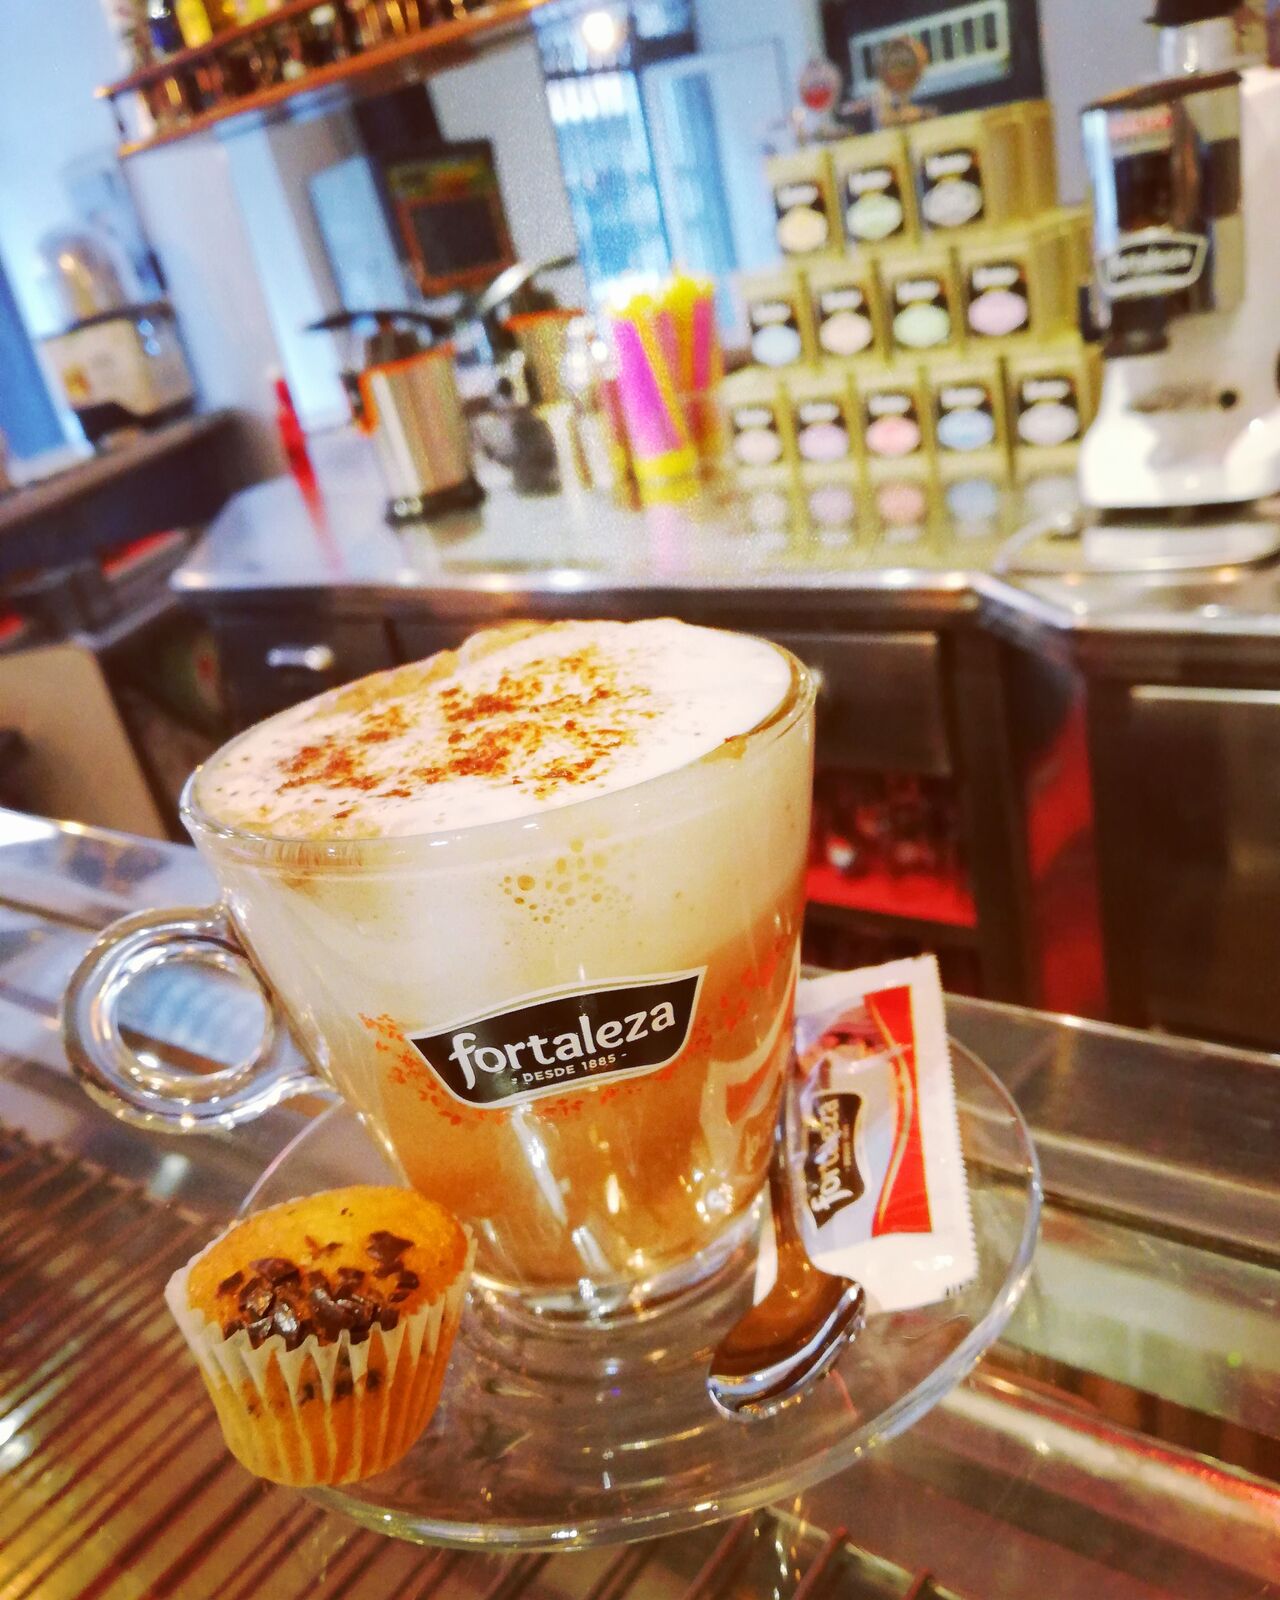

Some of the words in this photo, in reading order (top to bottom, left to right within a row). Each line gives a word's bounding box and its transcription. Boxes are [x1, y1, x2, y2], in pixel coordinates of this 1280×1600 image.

[448, 1001, 676, 1090] fortaleza
[522, 1064, 576, 1083] DESDE
[581, 1053, 617, 1070] 1885
[810, 1098, 854, 1211] forteza
